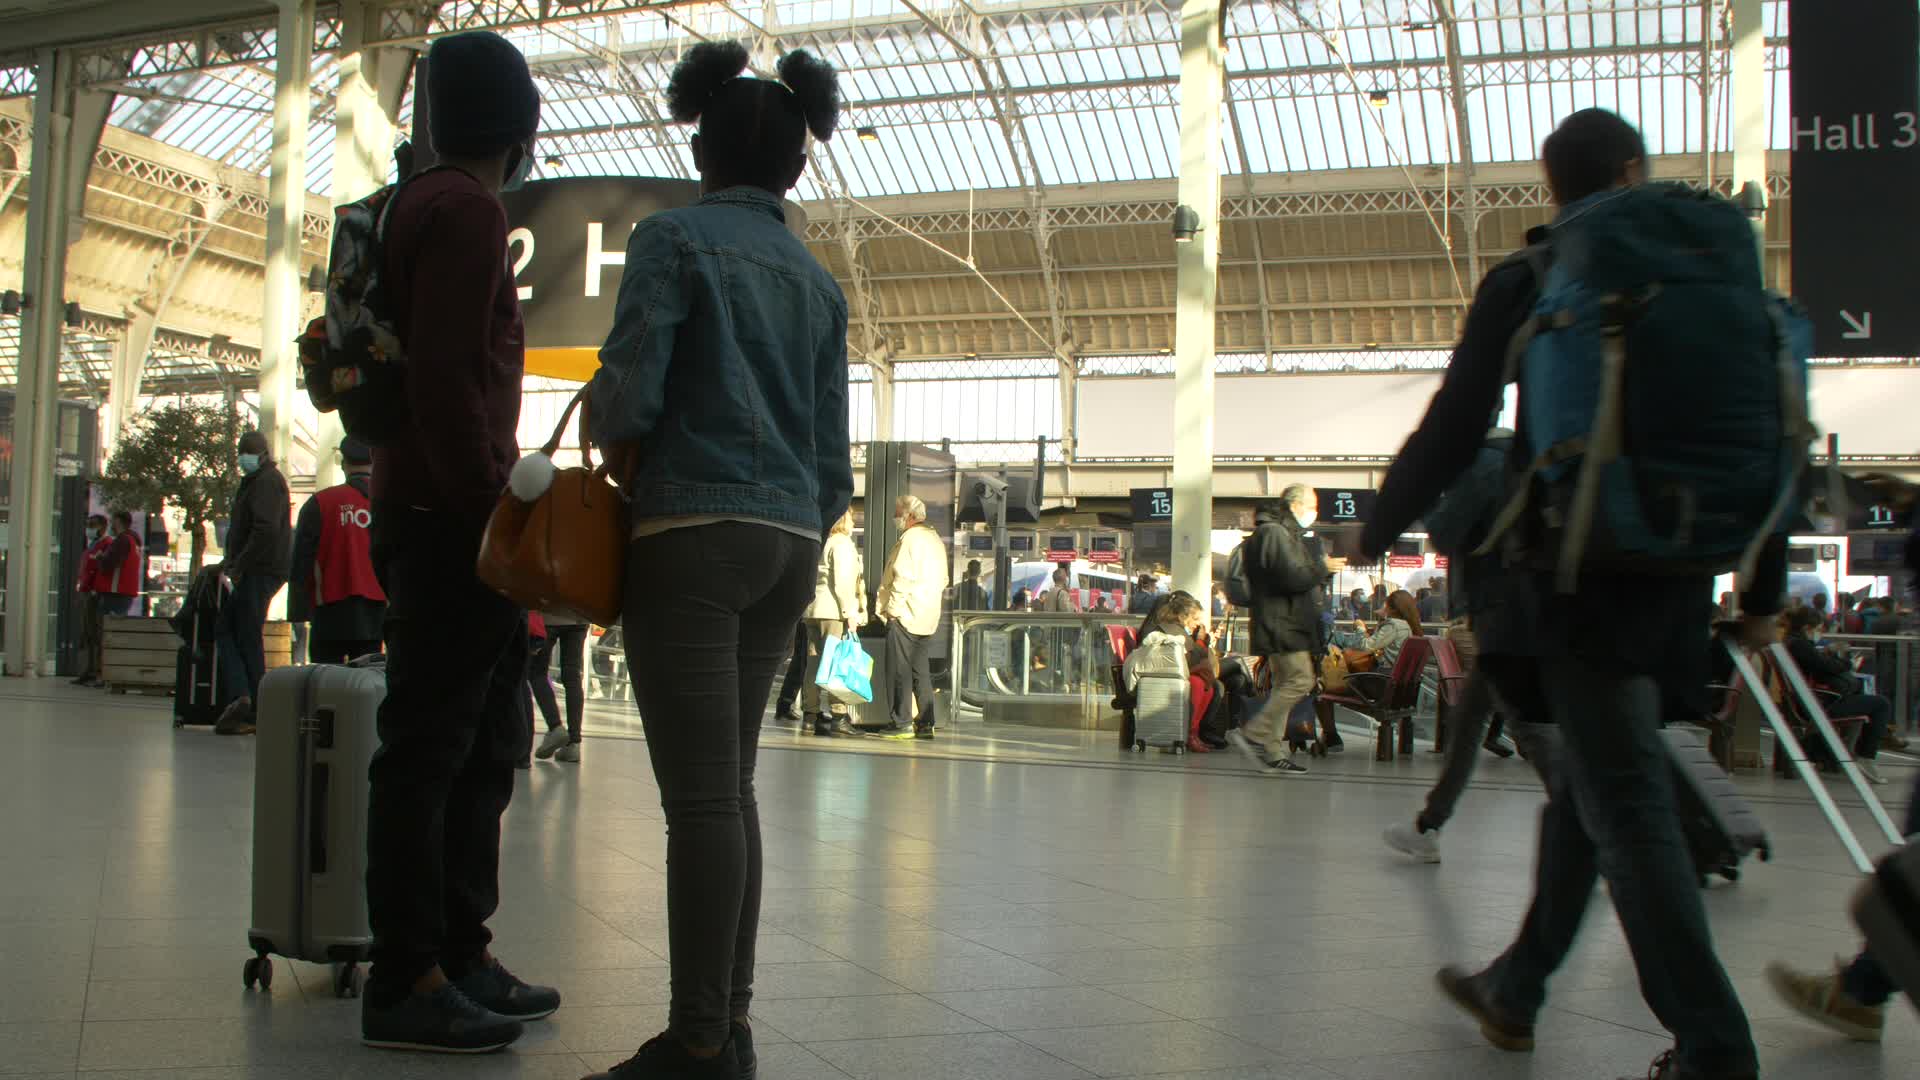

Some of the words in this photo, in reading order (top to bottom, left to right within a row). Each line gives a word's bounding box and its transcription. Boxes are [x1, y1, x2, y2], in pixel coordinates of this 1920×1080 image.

[1792, 114, 1879, 151] Hall
[1892, 111, 1917, 148] 3
[507, 227, 535, 301] 2
[1151, 498, 1171, 514] 15
[1335, 499, 1356, 515] 13
